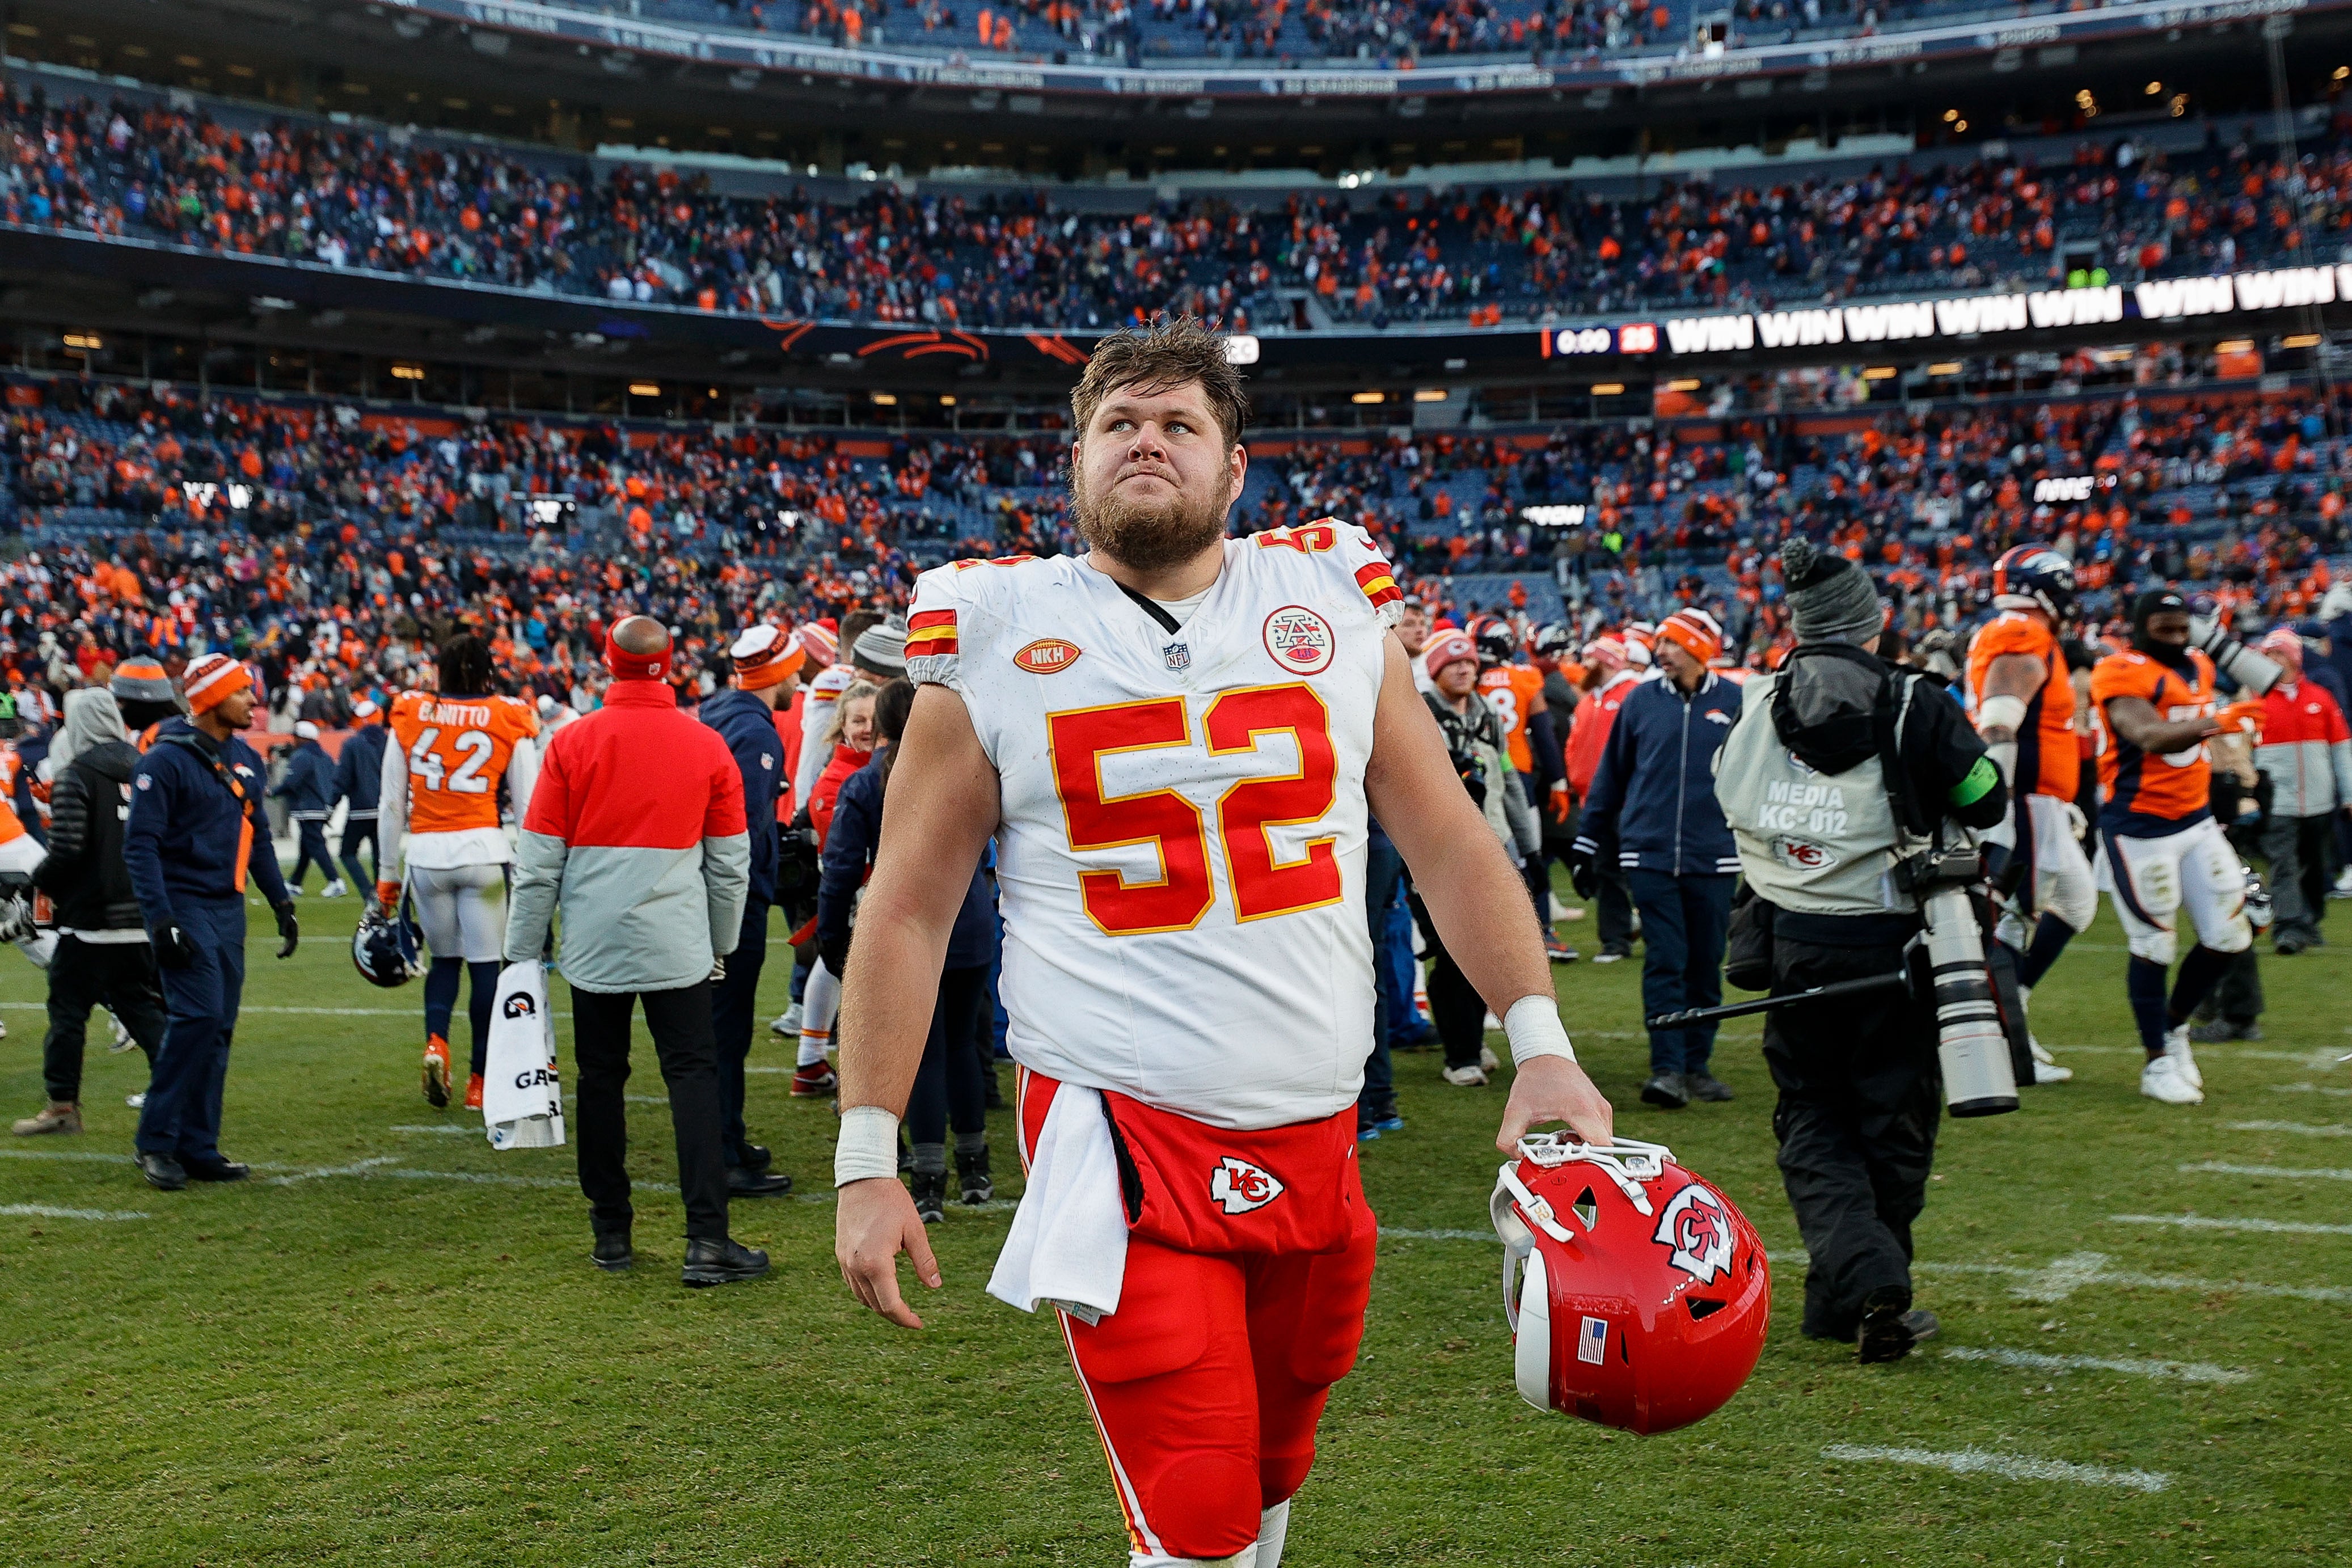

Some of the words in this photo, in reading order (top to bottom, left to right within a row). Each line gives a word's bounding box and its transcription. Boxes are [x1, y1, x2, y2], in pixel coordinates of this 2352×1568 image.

[1666, 314, 1754, 353] WIN
[1759, 307, 1844, 348] WIN
[1844, 301, 1934, 342] WIN
[1935, 293, 2027, 335] WIN
[2028, 285, 2123, 328] WIN
[2134, 274, 2233, 319] WIN
[2235, 265, 2335, 311] WIN
[1031, 646, 1065, 665] NKH
[1167, 653, 1189, 666] NFL
[408, 727, 493, 793] 42
[1046, 681, 1344, 936] 52
[1767, 780, 1843, 808] MEDIA
[1228, 1168, 1270, 1202] KC
[1534, 1204, 1551, 1222] 52
[1673, 1194, 1721, 1263] KC
